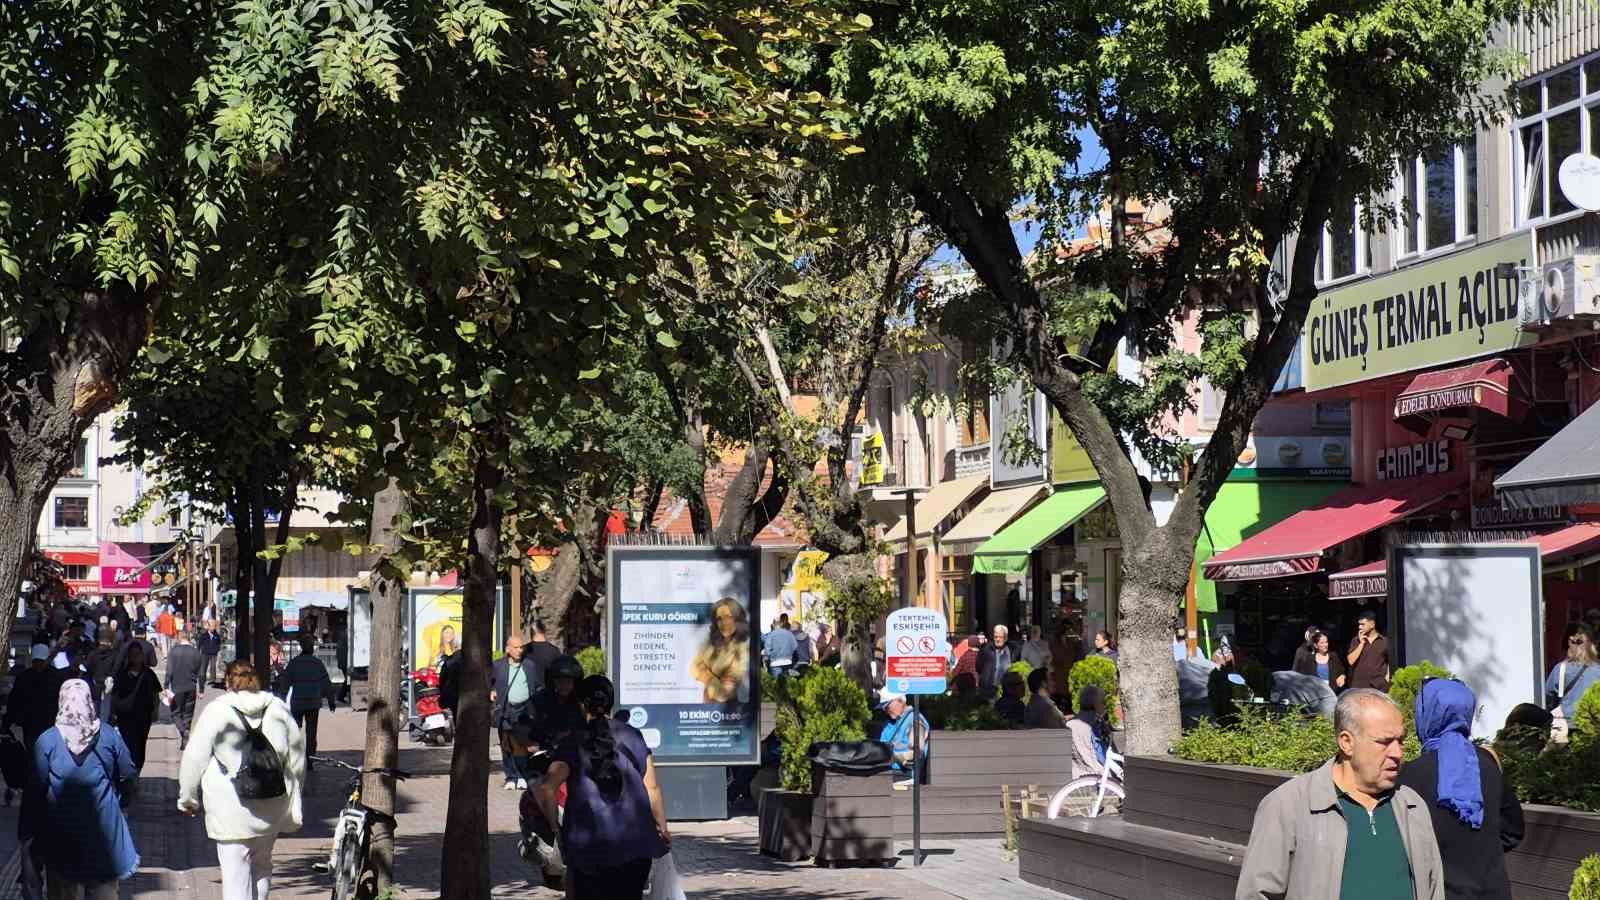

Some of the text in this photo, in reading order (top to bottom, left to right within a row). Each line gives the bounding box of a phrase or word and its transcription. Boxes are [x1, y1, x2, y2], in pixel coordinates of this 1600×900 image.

[1310, 300, 1369, 371] GÜNEŞ
[1373, 281, 1452, 351] TERMAL
[1430, 387, 1473, 409] DONDURMA
[1376, 439, 1449, 480] CAMPUS
[642, 613, 667, 621] KURU
[667, 611, 698, 621] GÖNEN
[633, 653, 676, 661] STRESTEN
[679, 711, 688, 719] 10
